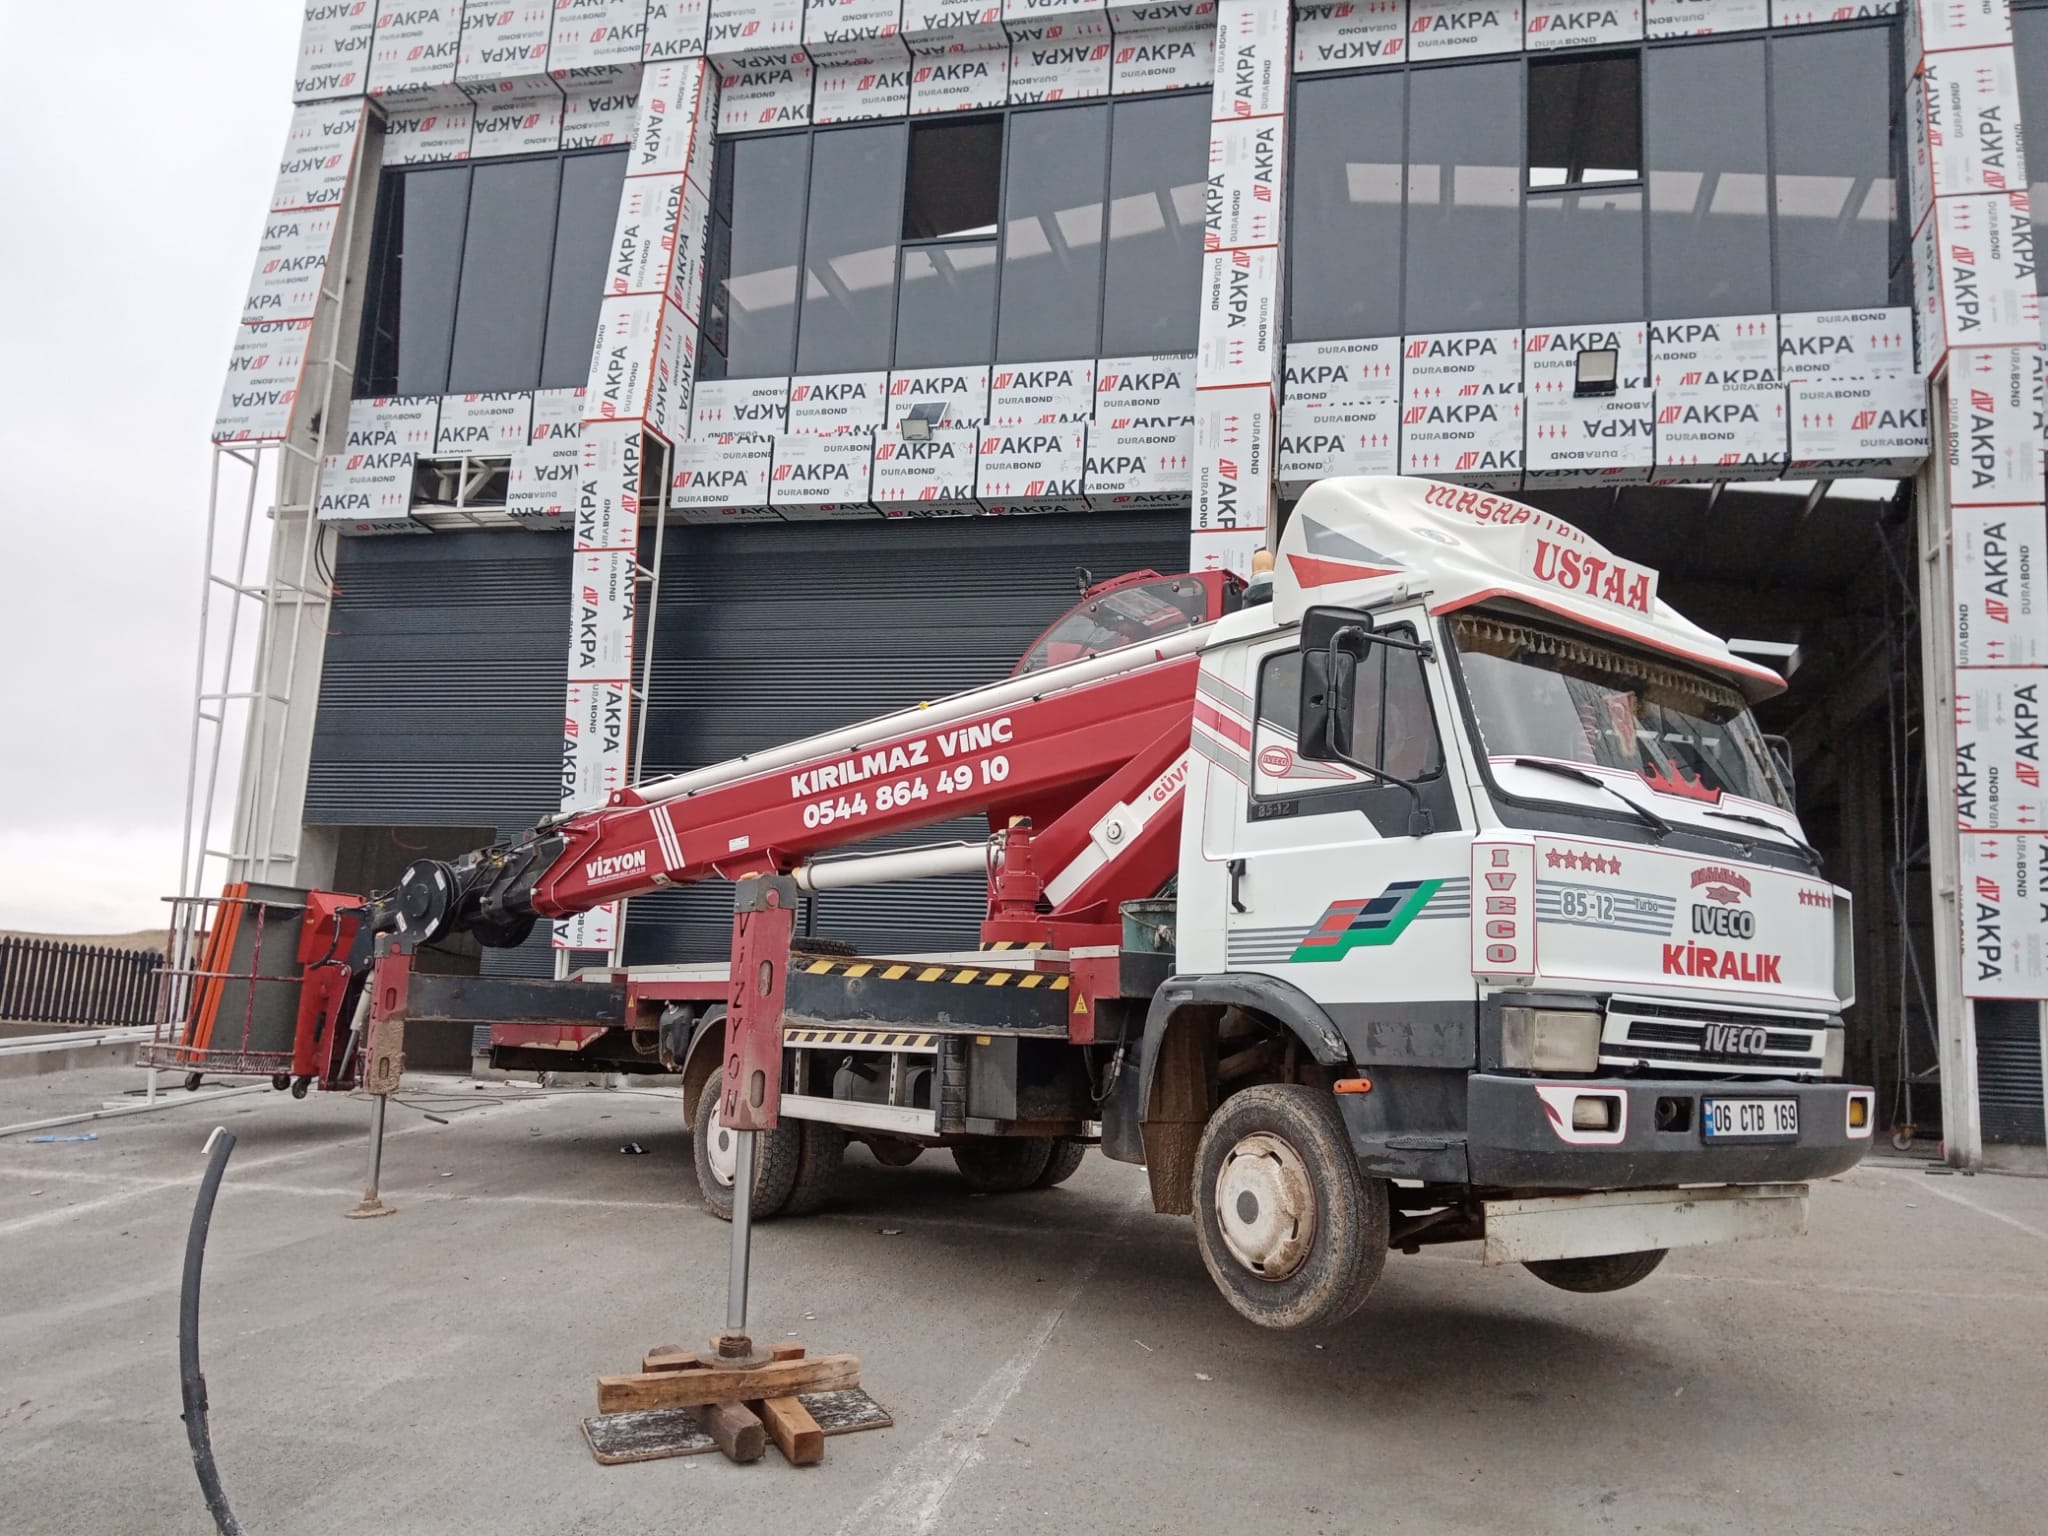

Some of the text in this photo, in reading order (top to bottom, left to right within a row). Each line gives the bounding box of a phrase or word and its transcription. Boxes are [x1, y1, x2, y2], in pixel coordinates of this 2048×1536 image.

[392, 10, 440, 27] AKPA
[1432, 10, 1500, 32] AKPA
[1550, 10, 1618, 32] AKPA
[1338, 23, 1397, 35] DURABOND
[650, 39, 702, 56] AKPA
[1318, 39, 1382, 60] AKPA
[1417, 35, 1478, 48] DURABOND
[482, 45, 531, 63] AKPA
[1031, 46, 1089, 66] AKPA
[1135, 42, 1195, 63] AKPA
[740, 69, 793, 86] AKPA
[932, 62, 987, 81] AKPA
[1236, 44, 1256, 98] AKPA
[918, 86, 969, 97] DURABOND
[588, 93, 639, 111] AKPA
[475, 115, 524, 133] AKPA
[641, 115, 663, 165] AKPA
[1978, 105, 2005, 168] AKPA
[1254, 127, 1274, 182] AKPA
[280, 157, 327, 174] AKPA
[1206, 173, 1225, 229] AKPA
[264, 223, 299, 240] KPA
[617, 224, 640, 276] AKPA
[2011, 214, 2034, 279] AKPA
[279, 255, 327, 272] AKPA
[636, 240, 650, 288] DURABOND
[1211, 258, 1222, 310] DURABOND
[247, 294, 282, 310] KPA
[1227, 269, 1249, 328] AKPA
[1952, 267, 1982, 332] AKPA
[1258, 297, 1268, 352] DURABOND
[1817, 313, 1887, 324] DURABOND
[1550, 331, 1622, 352] AKPA
[1650, 323, 1720, 344] AKPA
[1318, 344, 1379, 354] DURABOND
[1428, 337, 1497, 357] AKPA
[1780, 336, 1854, 356] AKPA
[604, 345, 627, 400] AKPA
[1012, 371, 1073, 388] AKPA
[1285, 366, 1349, 385] AKPA
[1413, 365, 1475, 375] DURABOND
[624, 361, 639, 413] DURABOND
[810, 384, 867, 401] AKPA
[910, 377, 968, 394] AKPA
[1118, 372, 1182, 394] AKPA
[232, 391, 281, 408] AKPA
[998, 396, 1053, 405] DURABOND
[1103, 398, 1160, 408] DURABOND
[1800, 390, 1871, 400] DURABOND
[734, 404, 788, 420] AKPA
[796, 408, 848, 416] DURABOND
[1314, 413, 1376, 424] DURABOND
[1427, 404, 1498, 424] AKPA
[1683, 404, 1758, 424] AKPA
[348, 430, 397, 446] AKPA
[439, 426, 490, 443] AKPA
[1411, 431, 1475, 440] DURABOND
[1583, 419, 1653, 438] AKPA
[1666, 432, 1735, 441] DURABOND
[1000, 435, 1062, 454] AKPA
[1117, 435, 1175, 444] DURABOND
[1251, 413, 1261, 475] DURABOND
[1280, 435, 1345, 455] AKPA
[896, 442, 955, 459] AKPA
[1551, 450, 1618, 460] DURABOND
[1971, 414, 1996, 489] AKPA
[363, 453, 413, 469] AKPA
[623, 433, 641, 494] AKPA
[985, 461, 1041, 470] DURABOND
[1086, 456, 1146, 475] AKPA
[691, 471, 748, 488] AKPA
[792, 464, 849, 480] AKPA
[881, 467, 935, 476] DURABOND
[320, 493, 371, 511] AKPA
[677, 495, 729, 503] DURABOND
[777, 488, 830, 496] DURABOND
[1200, 467, 1209, 528] DURABOND
[579, 480, 598, 541] AKPA
[1983, 522, 2009, 598] AKPA
[1533, 538, 1651, 614] USTAA
[2020, 545, 2032, 615] DURABOND
[580, 607, 598, 669] AKPA
[603, 691, 623, 754] AKPA
[2014, 684, 2039, 761] AKPA
[561, 740, 578, 800] AKPA
[790, 739, 929, 799] KIRILMAZ
[1956, 742, 1977, 820] AKPA
[803, 755, 1010, 829] 0544 864 49 10
[586, 849, 646, 879] VİZYON
[1692, 903, 1756, 940] IVECO
[1976, 902, 2002, 982] AKPA
[1662, 940, 1783, 984] KİRALIK
[1704, 1022, 1768, 1055] IVECO
[1714, 1104, 1796, 1132] 06 CTB 169
